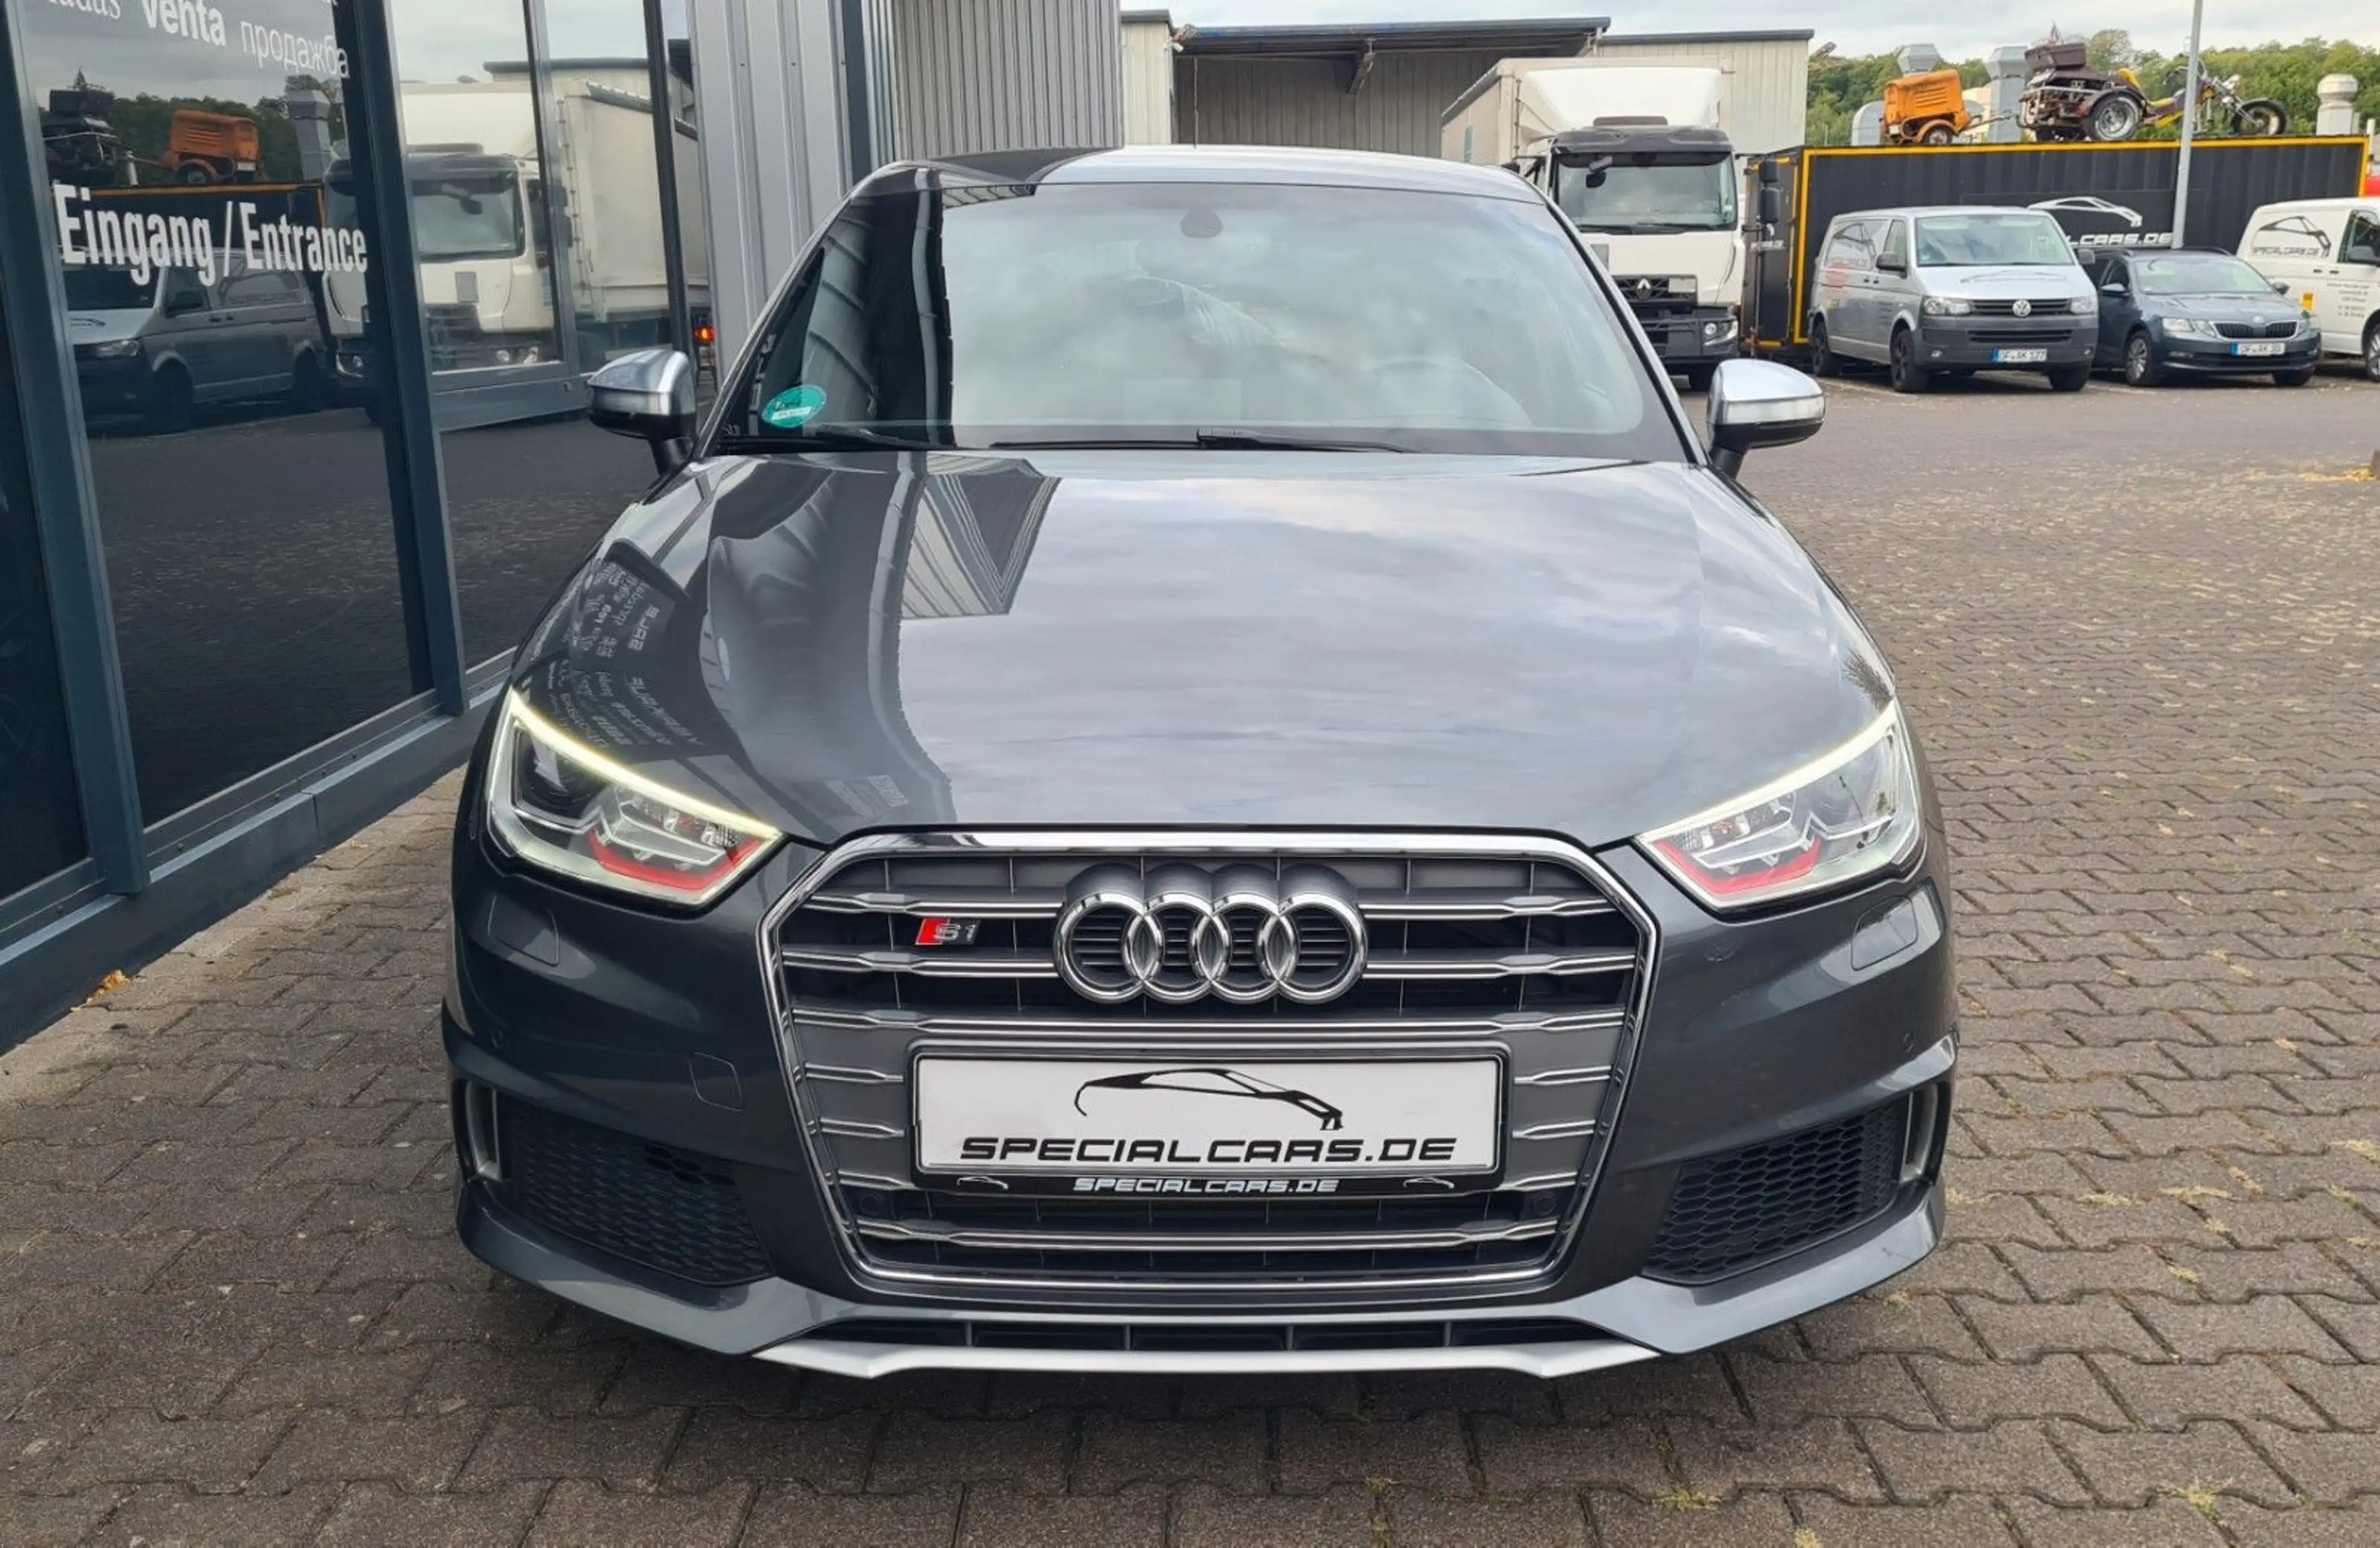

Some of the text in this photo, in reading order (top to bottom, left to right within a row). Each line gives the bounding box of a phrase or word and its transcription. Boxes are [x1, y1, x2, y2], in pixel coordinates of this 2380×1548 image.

[240, 21, 350, 79] продажба
[54, 184, 215, 286] Eingang
[959, 1137, 1457, 1163] SPECIALCARS.DE
[1073, 1177, 1339, 1193] SPECIALCARS.DE
